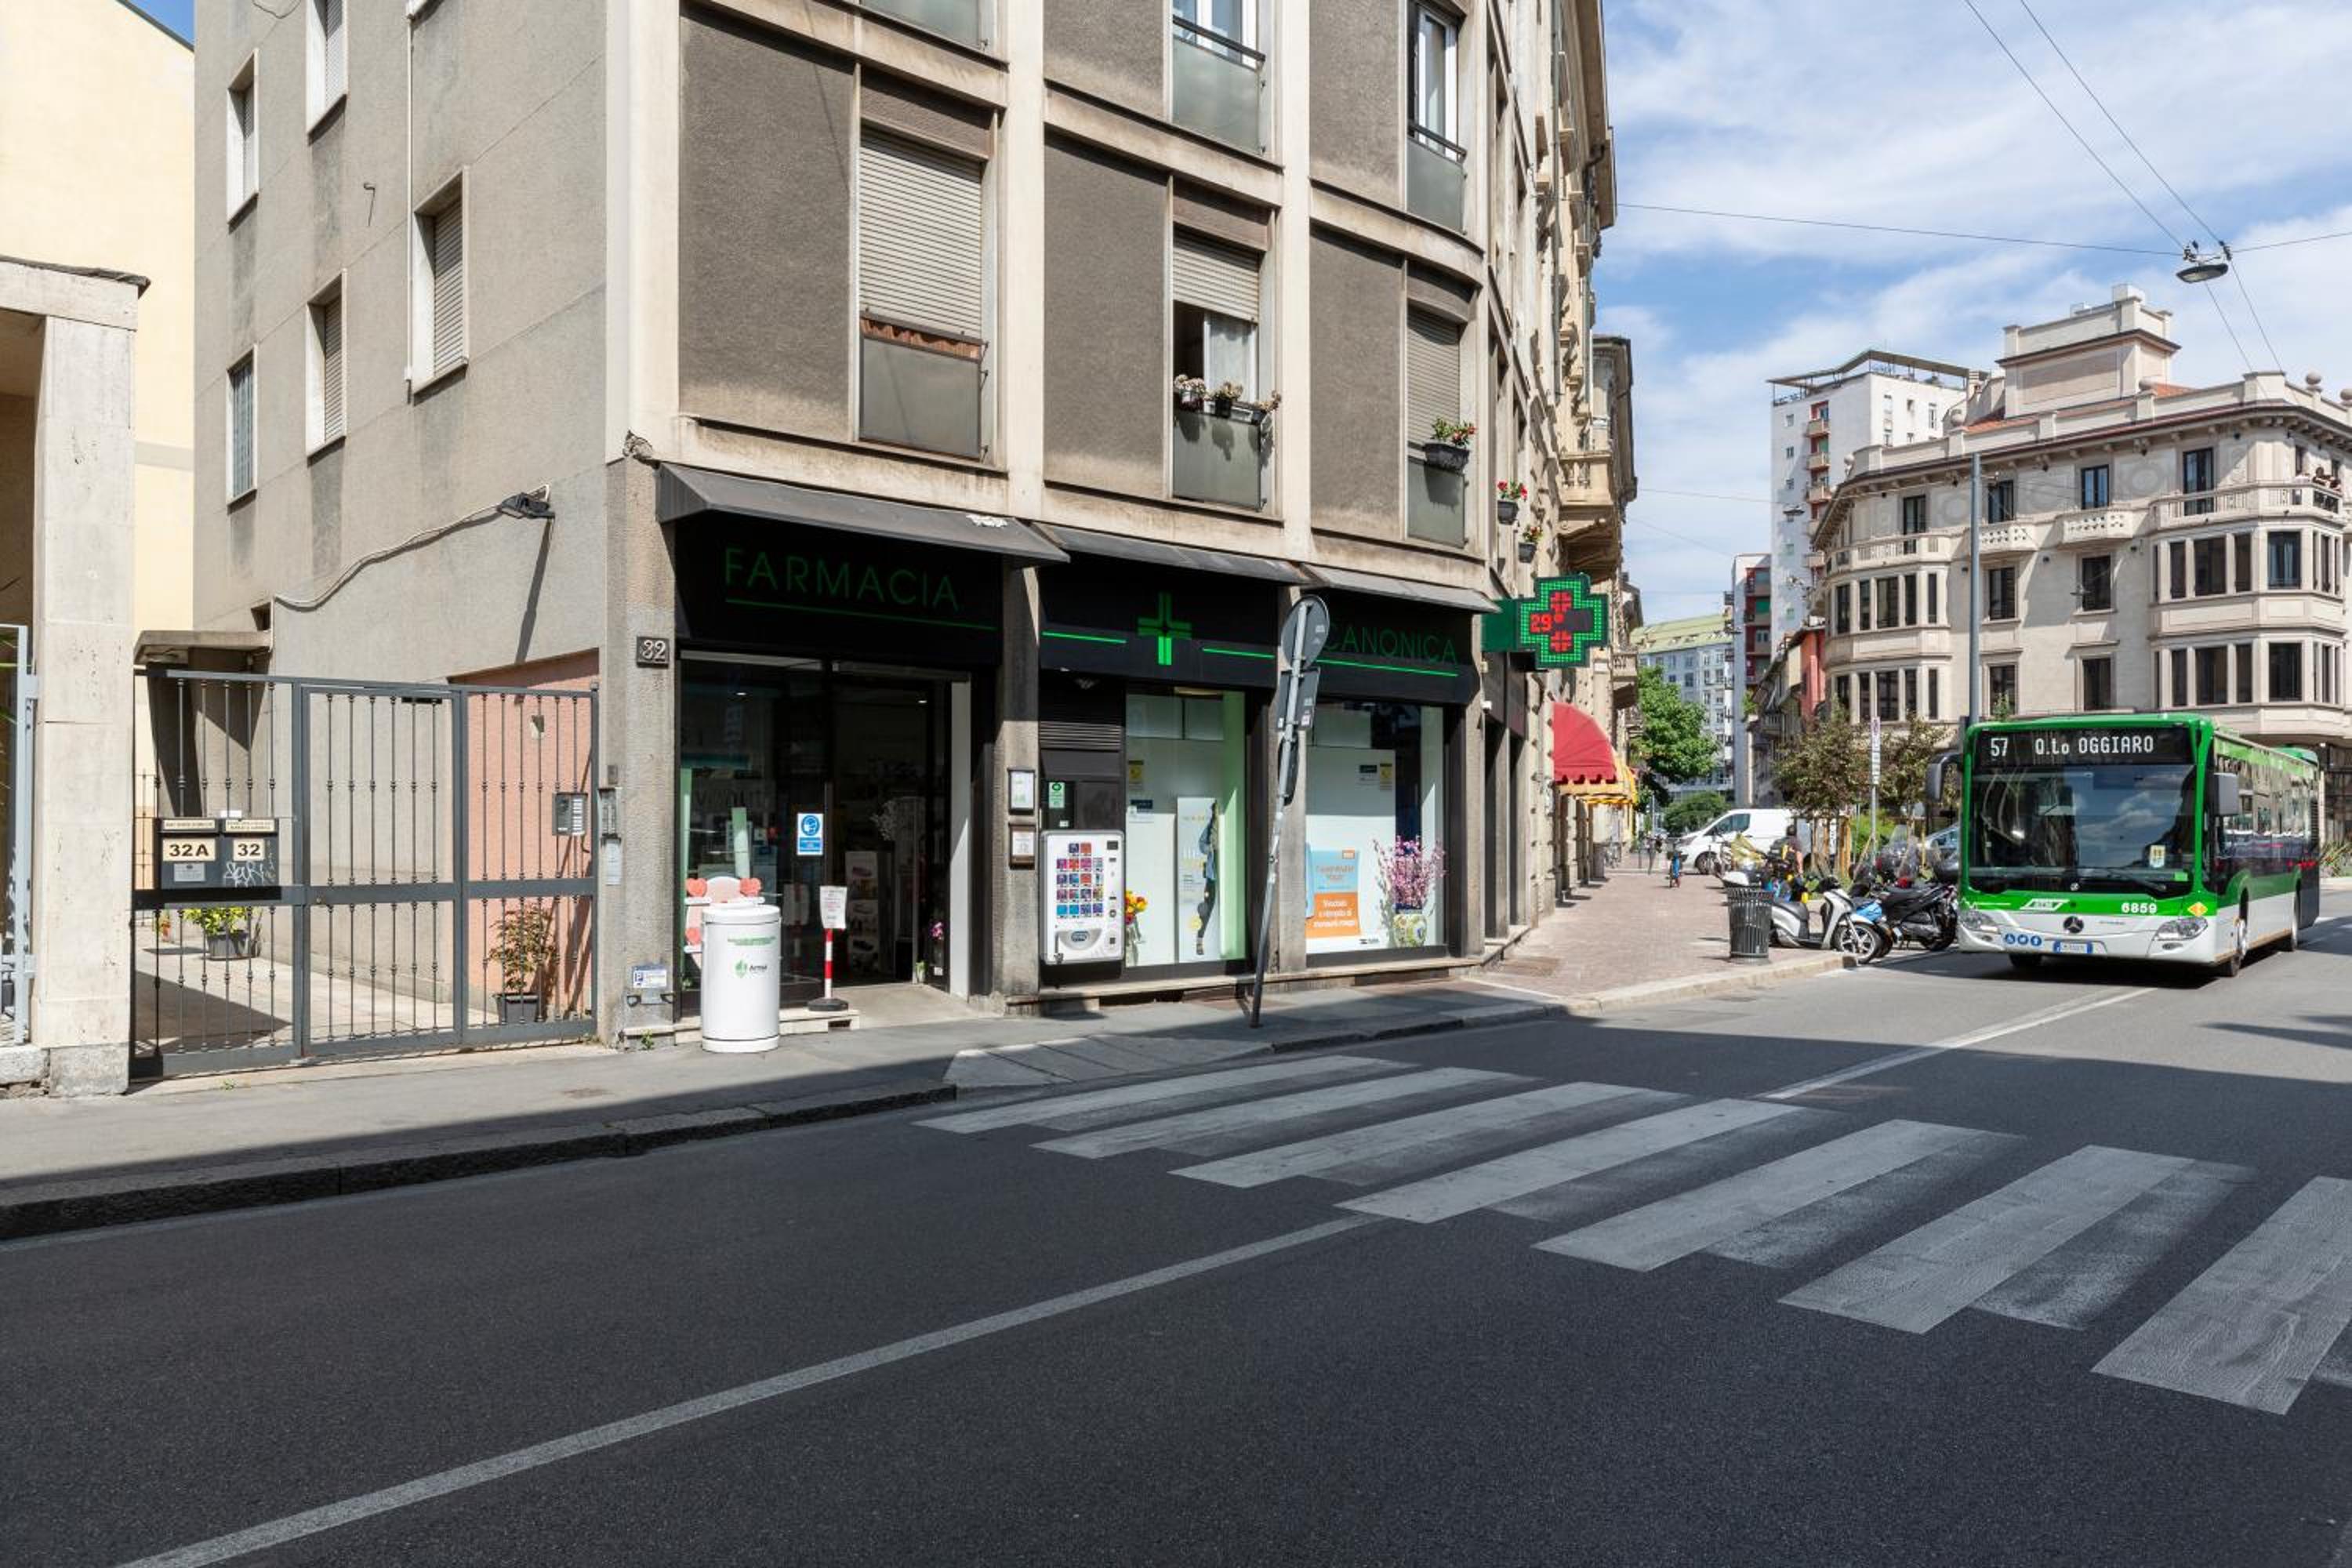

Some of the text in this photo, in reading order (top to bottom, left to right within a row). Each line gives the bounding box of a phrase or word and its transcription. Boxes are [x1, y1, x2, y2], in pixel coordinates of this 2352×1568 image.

[724, 546, 958, 612] FARMACIA
[642, 639, 666, 659] 32
[1991, 737, 2008, 757] 57
[2078, 735, 2154, 753] OGGIARO
[169, 844, 209, 857] 32A
[238, 843, 260, 857] 32
[2121, 902, 2158, 913] 6859
